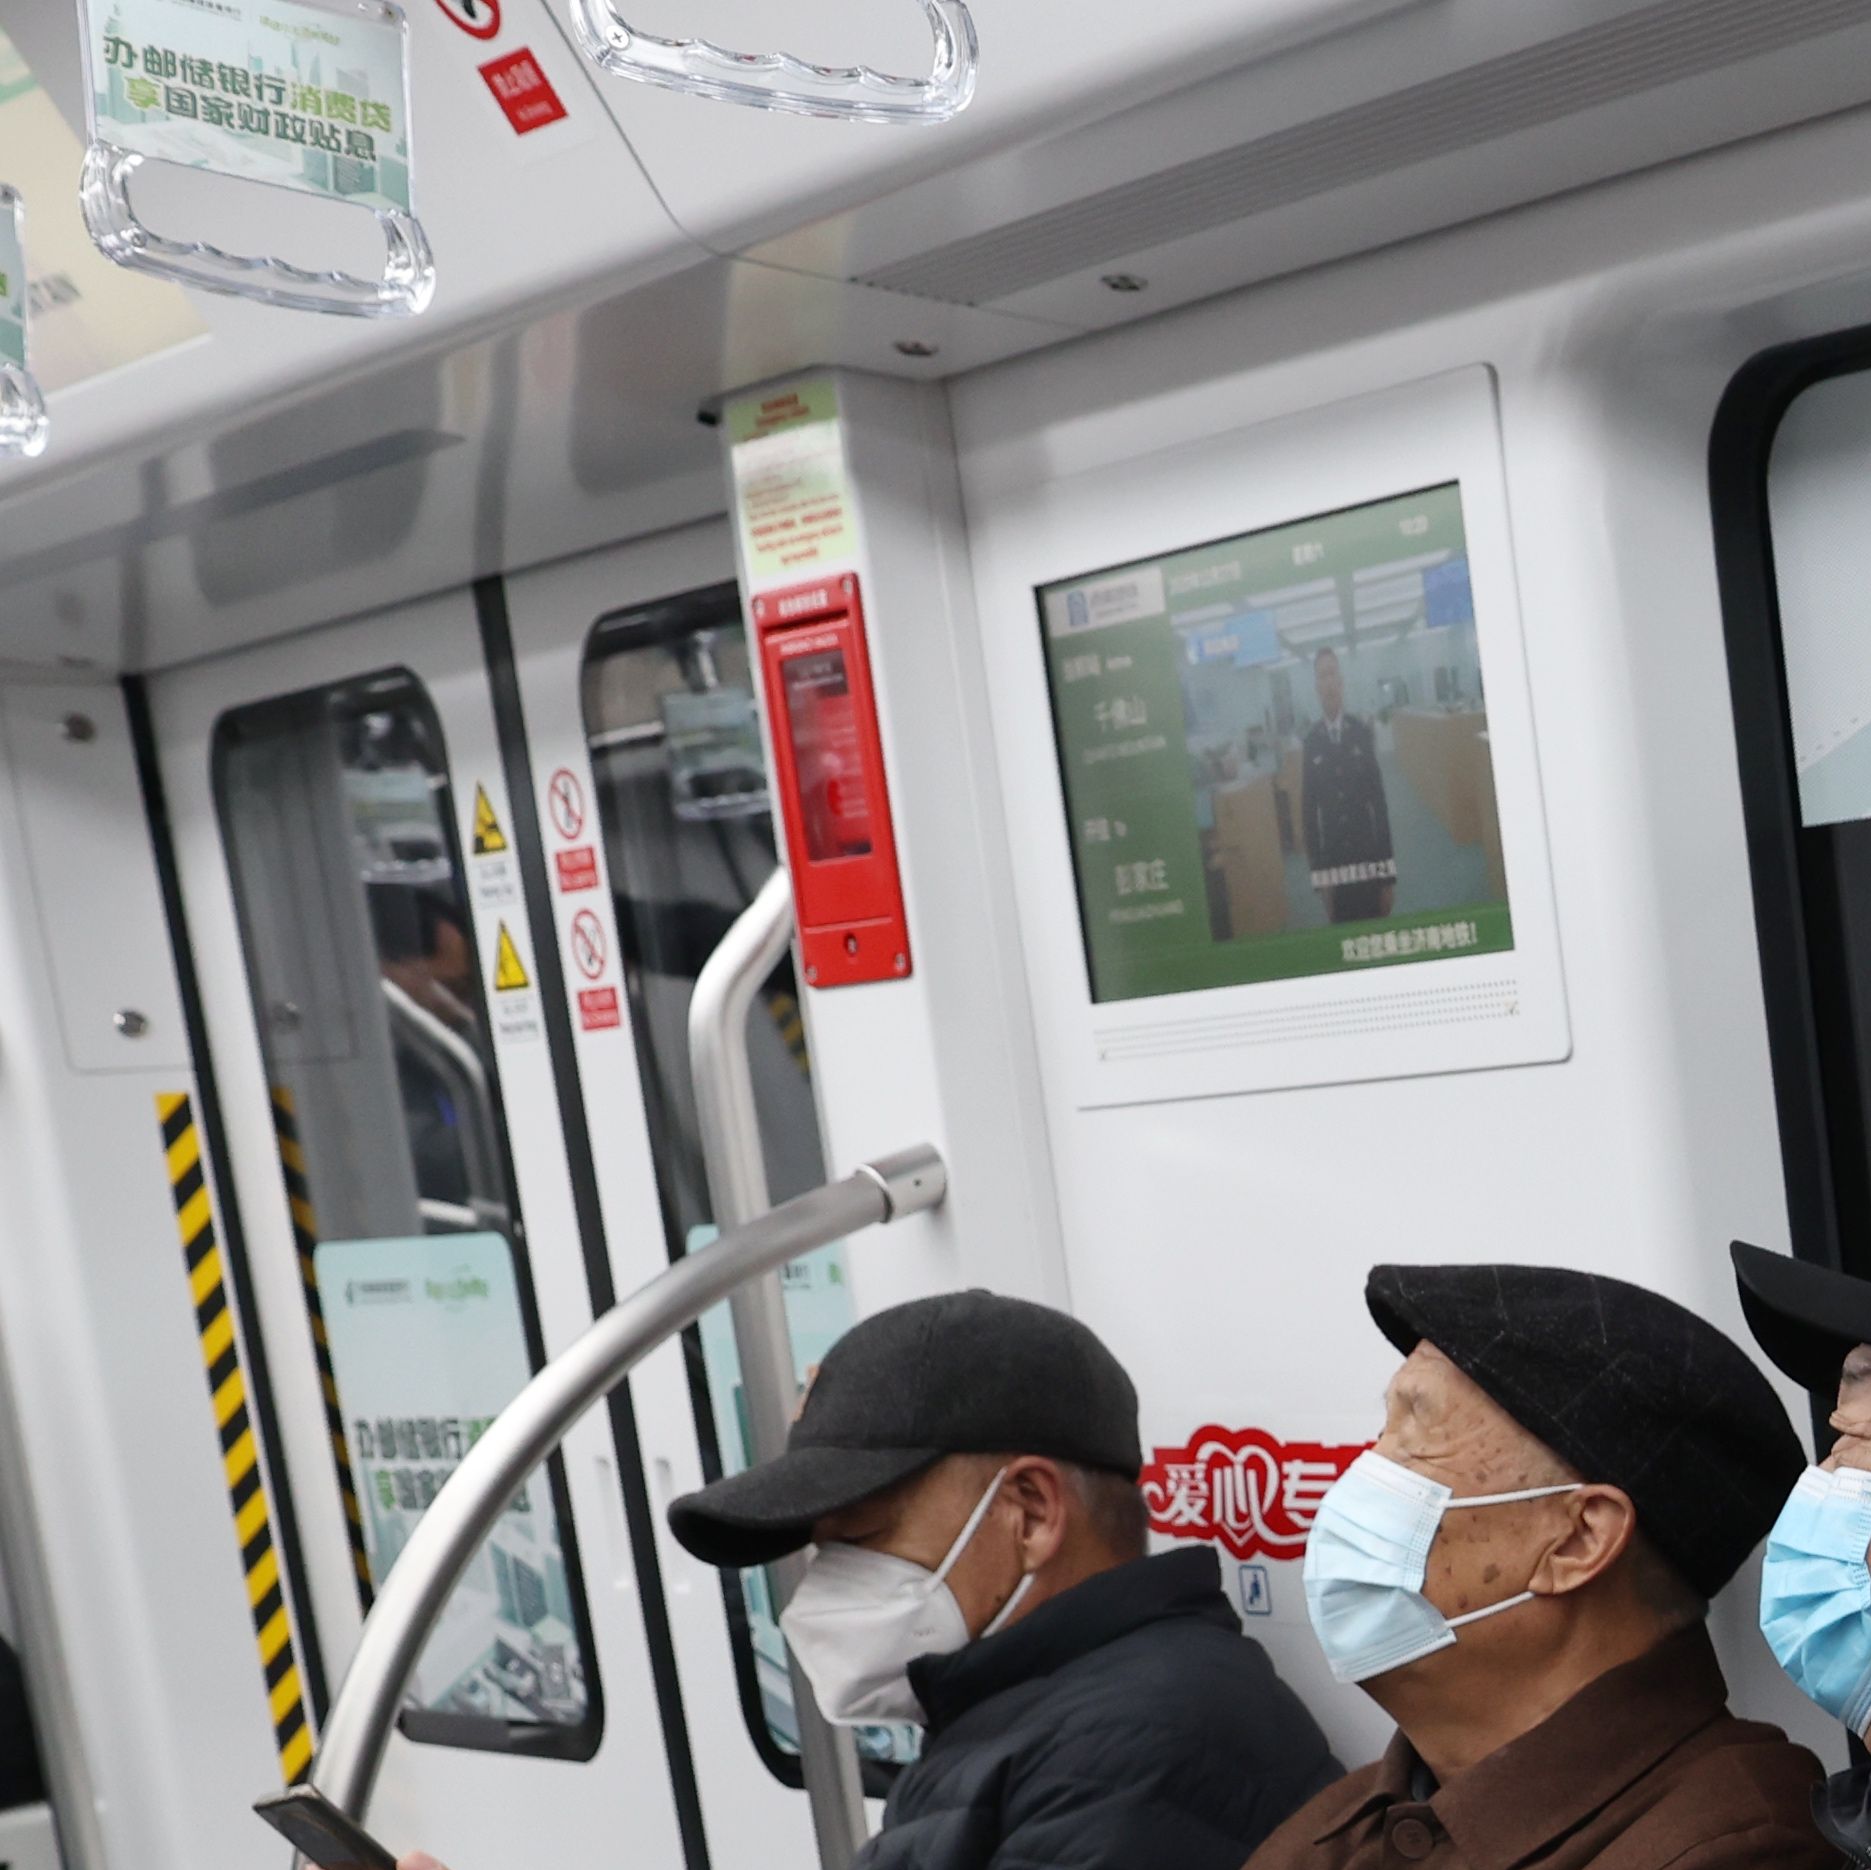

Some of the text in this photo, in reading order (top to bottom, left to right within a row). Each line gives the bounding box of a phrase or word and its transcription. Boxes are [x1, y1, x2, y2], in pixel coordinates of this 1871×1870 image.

[103, 35, 392, 132] 办邮储银行消费贷
[125, 76, 376, 162] 享国家财政贴息
